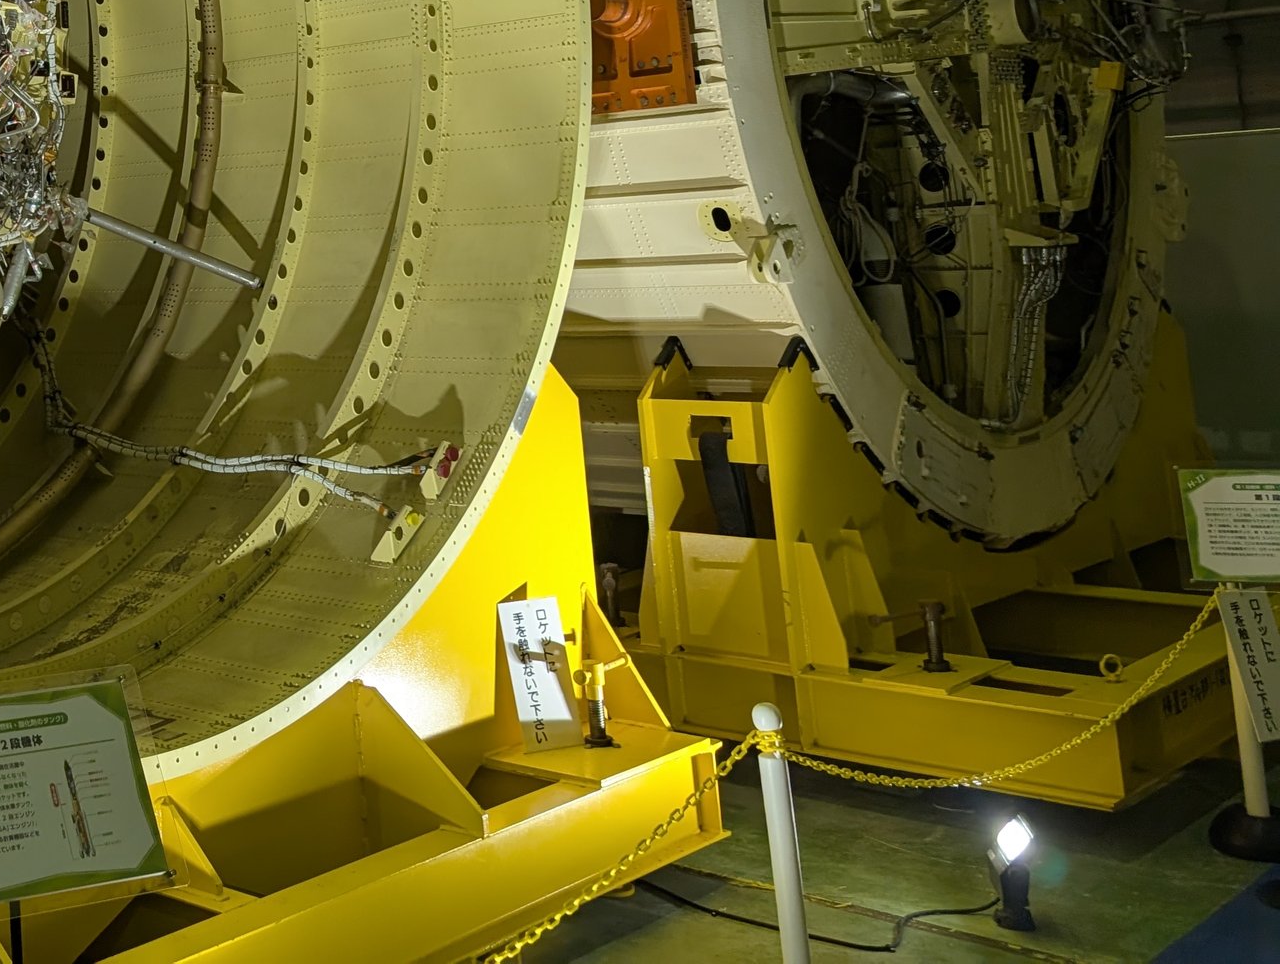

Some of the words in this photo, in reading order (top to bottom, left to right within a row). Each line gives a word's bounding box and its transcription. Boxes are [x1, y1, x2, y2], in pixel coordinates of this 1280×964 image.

[513, 612, 548, 744] 手を触れないで下さい
[536, 608, 558, 673] ロケットに
[1230, 602, 1277, 733] 手を触れないで下さい
[1249, 598, 1277, 663] ロケットに
